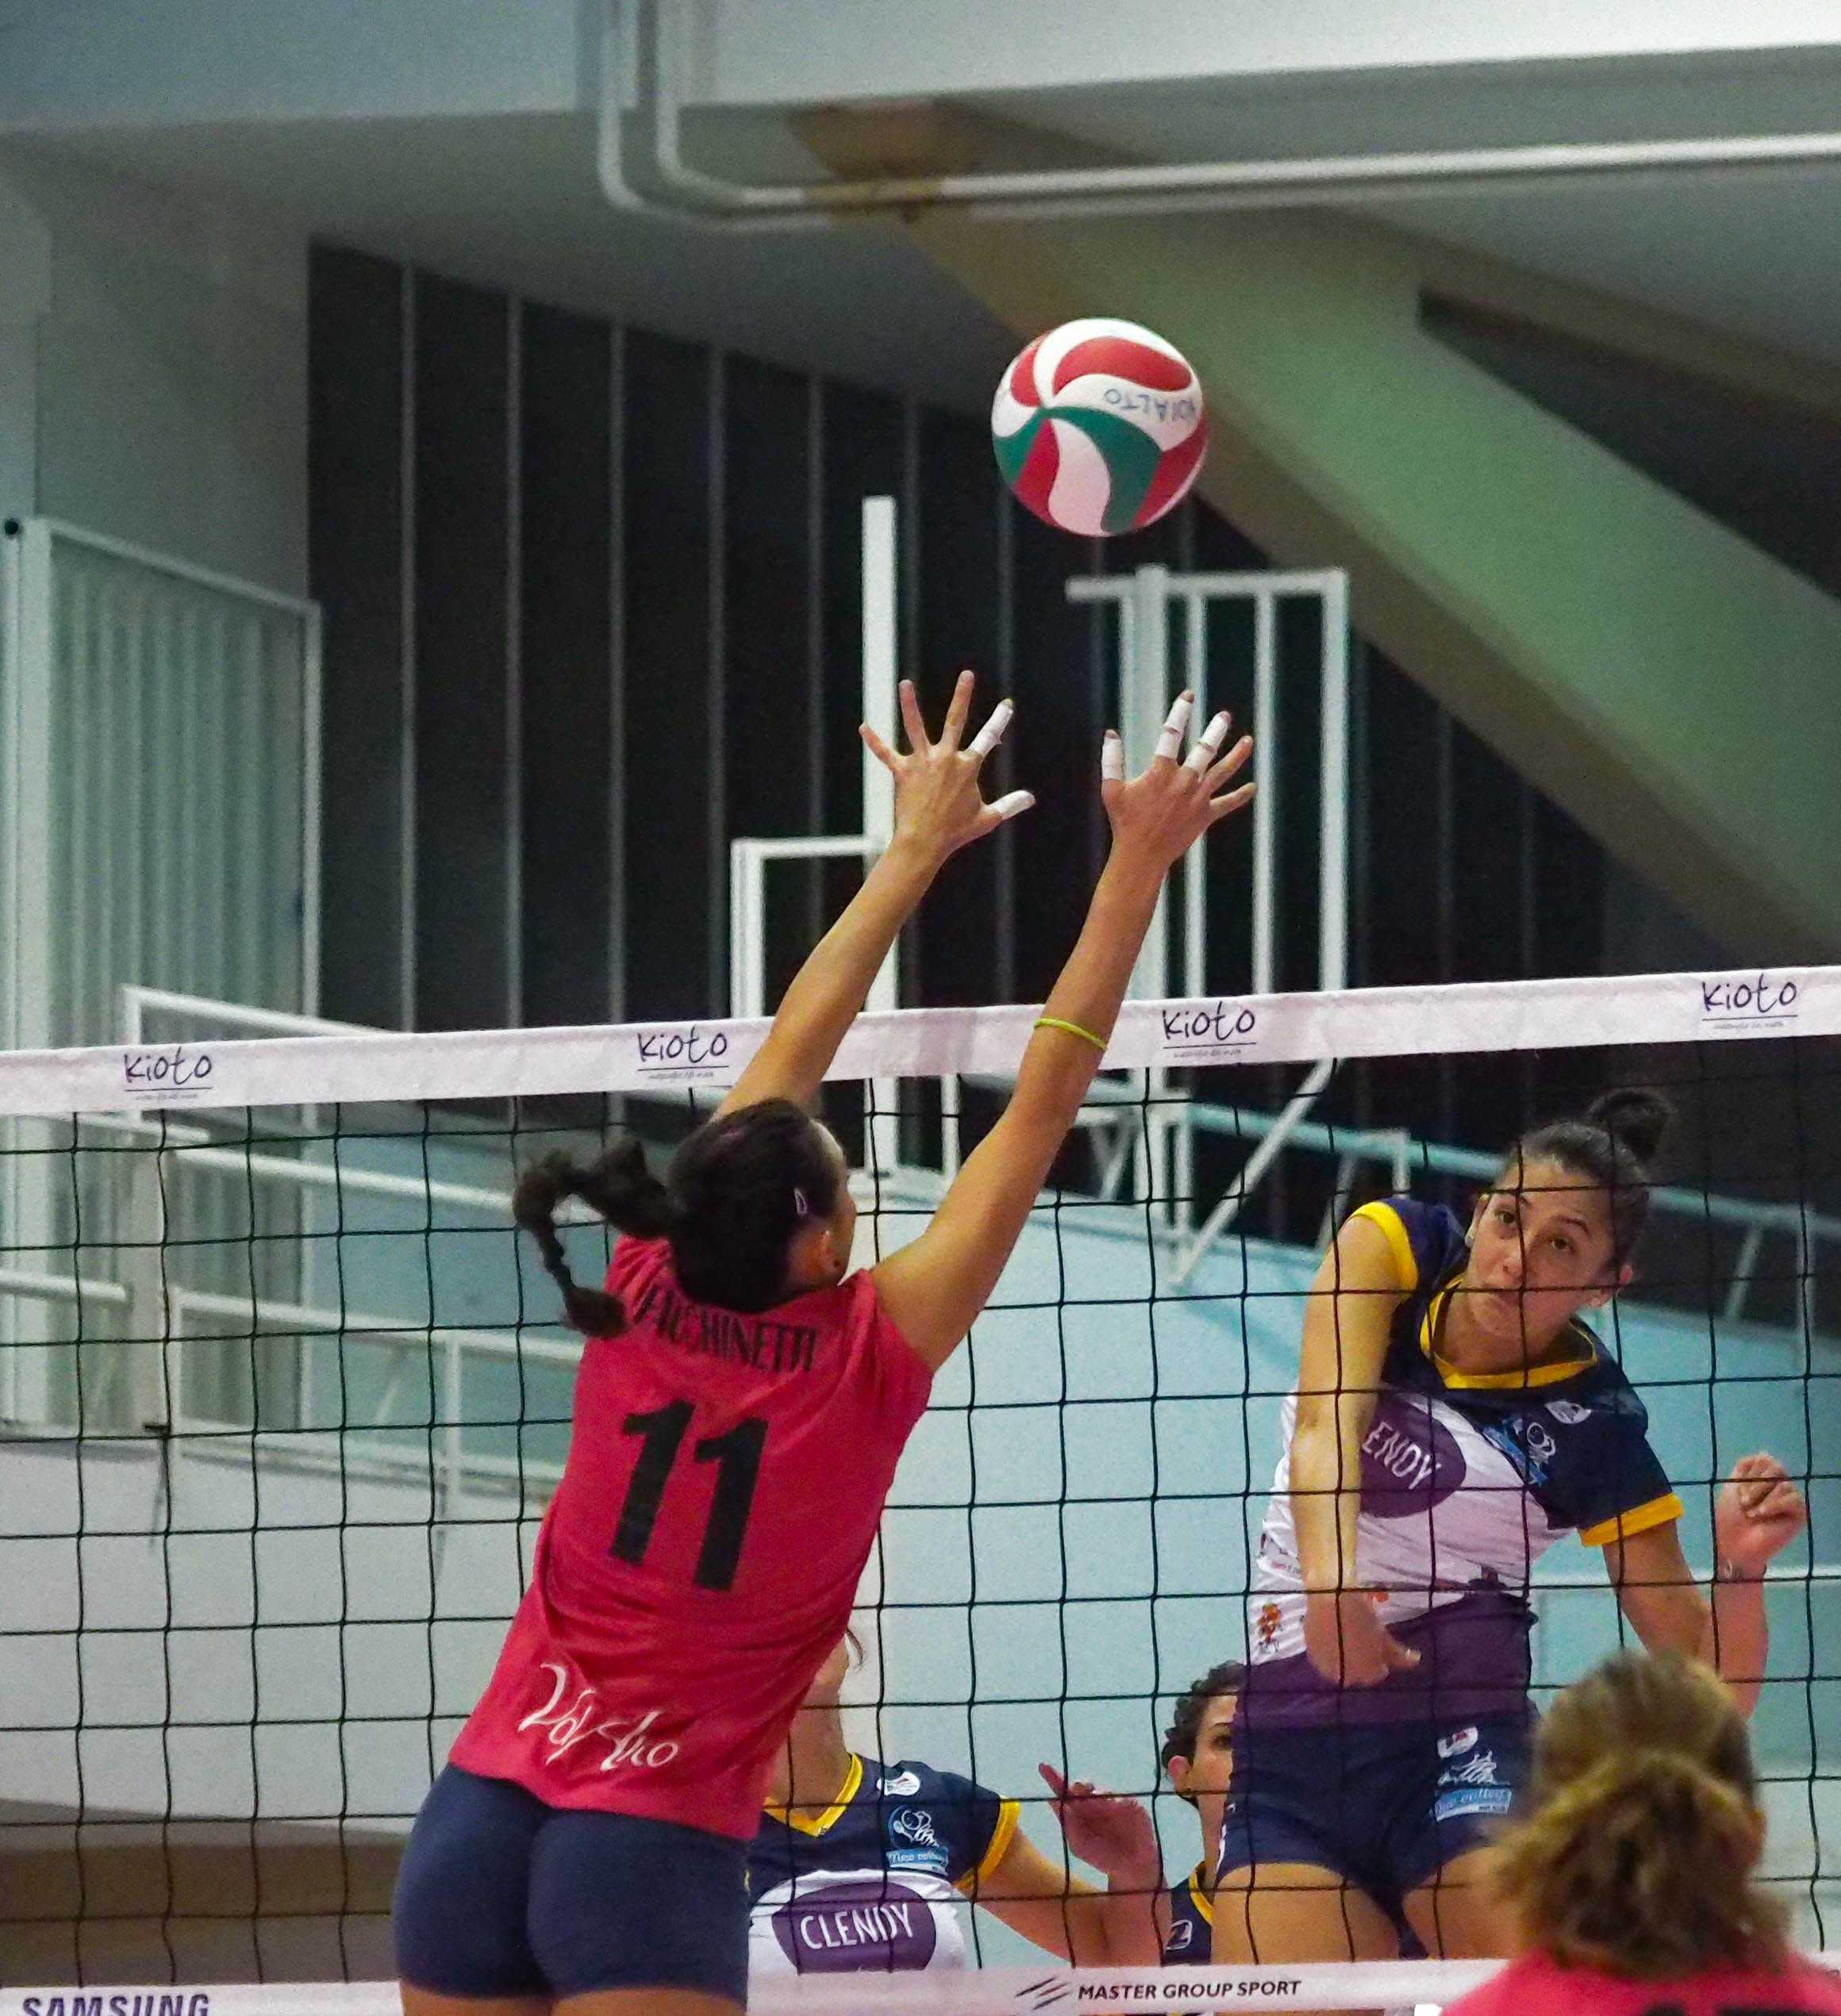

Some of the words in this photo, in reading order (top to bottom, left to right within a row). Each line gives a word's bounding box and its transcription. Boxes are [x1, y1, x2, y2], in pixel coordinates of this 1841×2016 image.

[1361, 1421, 1442, 1490] ENDY
[609, 1396, 770, 1592] 11
[800, 1902, 913, 1950] CLENDY
[1078, 1983, 1157, 2000] MASTER
[1163, 1982, 1233, 1999] GROUP
[1236, 1980, 1302, 1997] SPORT
